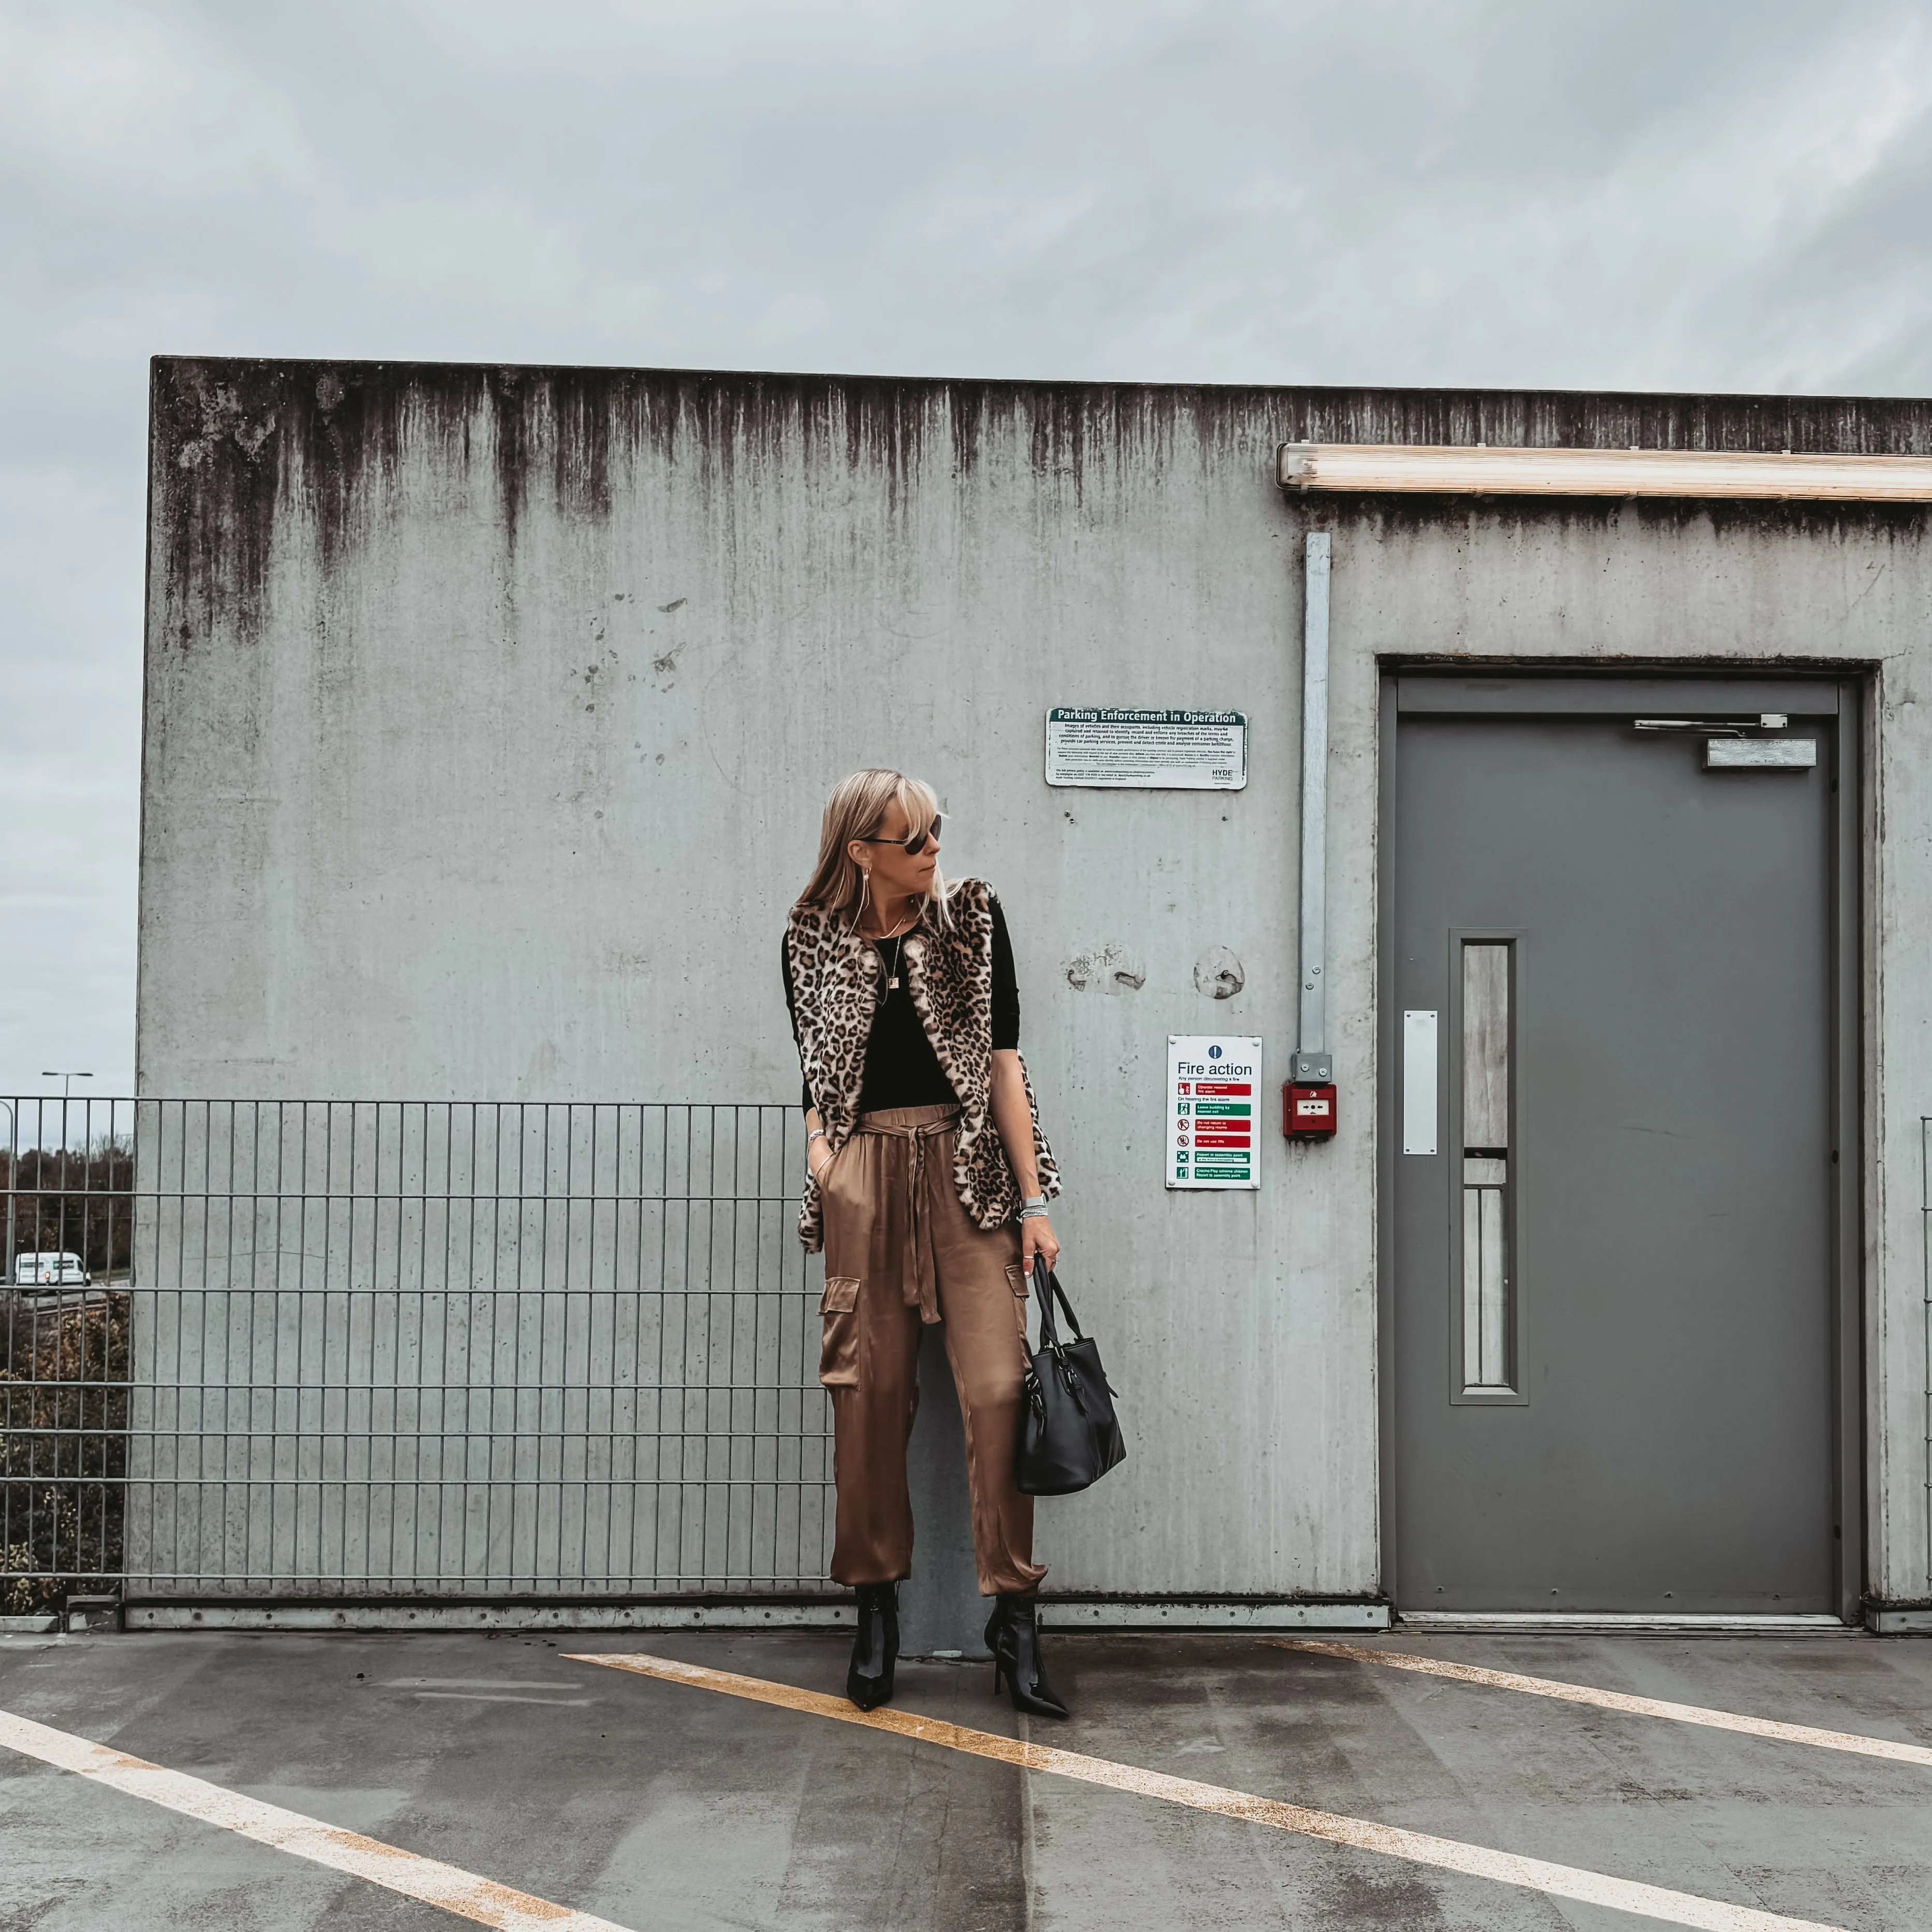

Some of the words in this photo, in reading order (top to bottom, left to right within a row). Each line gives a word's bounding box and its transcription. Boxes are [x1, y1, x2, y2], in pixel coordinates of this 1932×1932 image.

[1058, 710, 1097, 722] Parking
[1101, 710, 1167, 721] Enforcement
[1170, 712, 1180, 721] in
[1184, 712, 1236, 724] Operation
[1178, 1062, 1204, 1074] Fire
[1209, 1063, 1252, 1075] action
